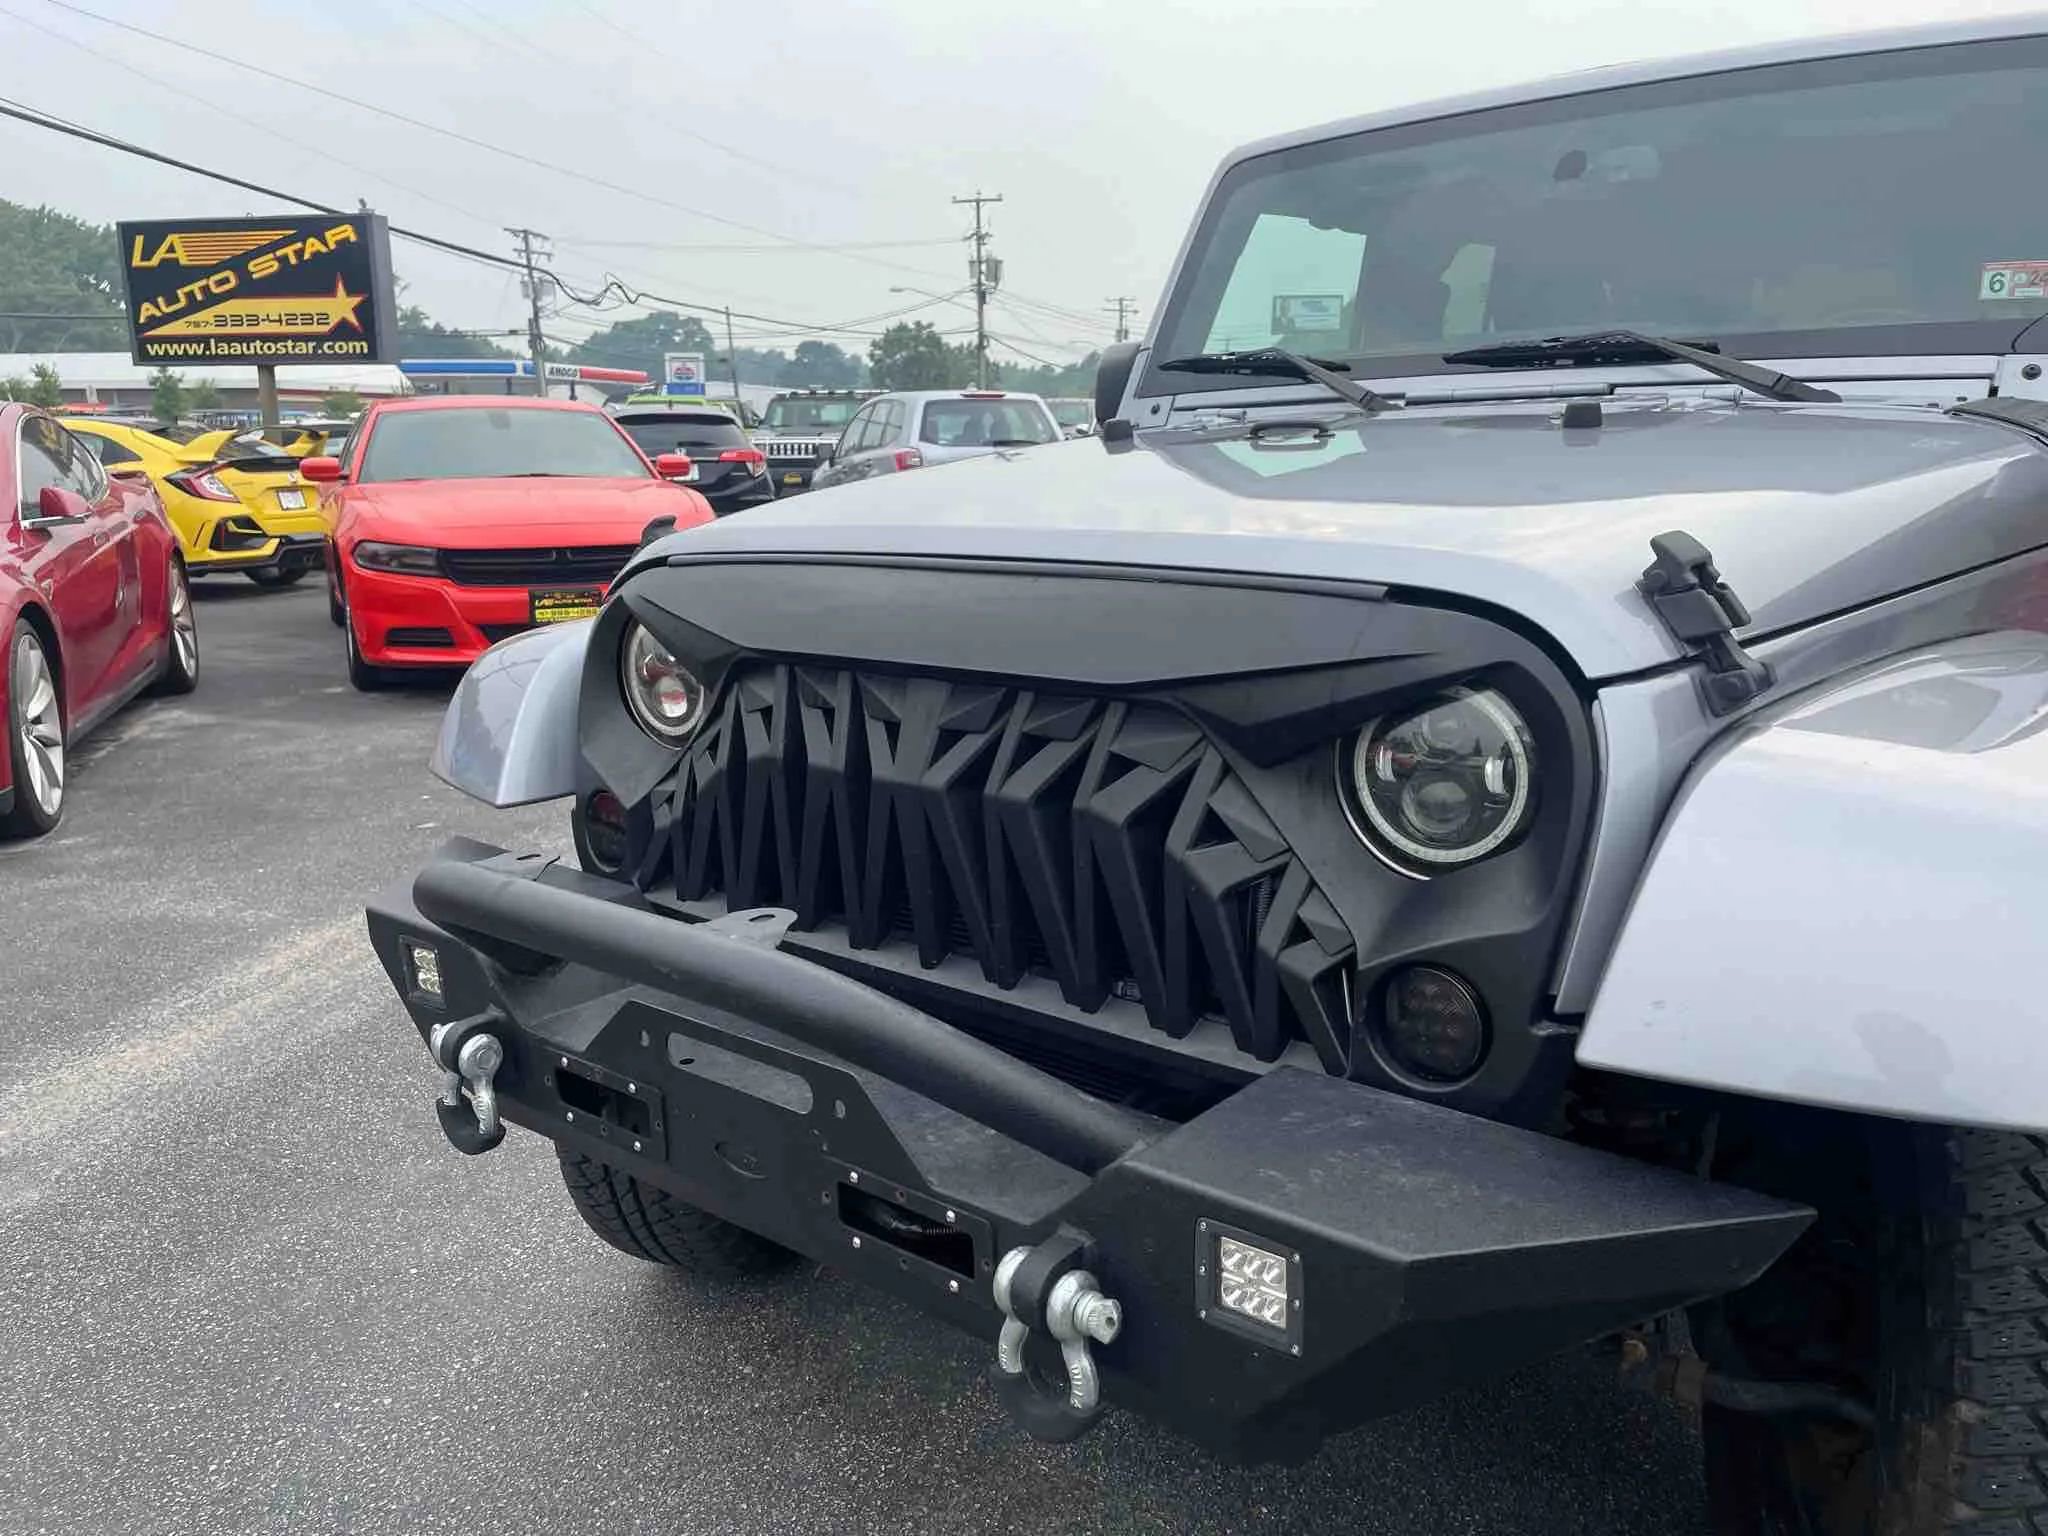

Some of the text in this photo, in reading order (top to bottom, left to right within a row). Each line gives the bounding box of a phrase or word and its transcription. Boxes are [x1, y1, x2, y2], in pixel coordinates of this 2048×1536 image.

[131, 233, 188, 267] LA
[139, 224, 357, 324] AUTO STAR
[1989, 271, 2006, 294] 6
[146, 338, 369, 356] www.laautostar.com
[548, 366, 578, 378] AMOCO
